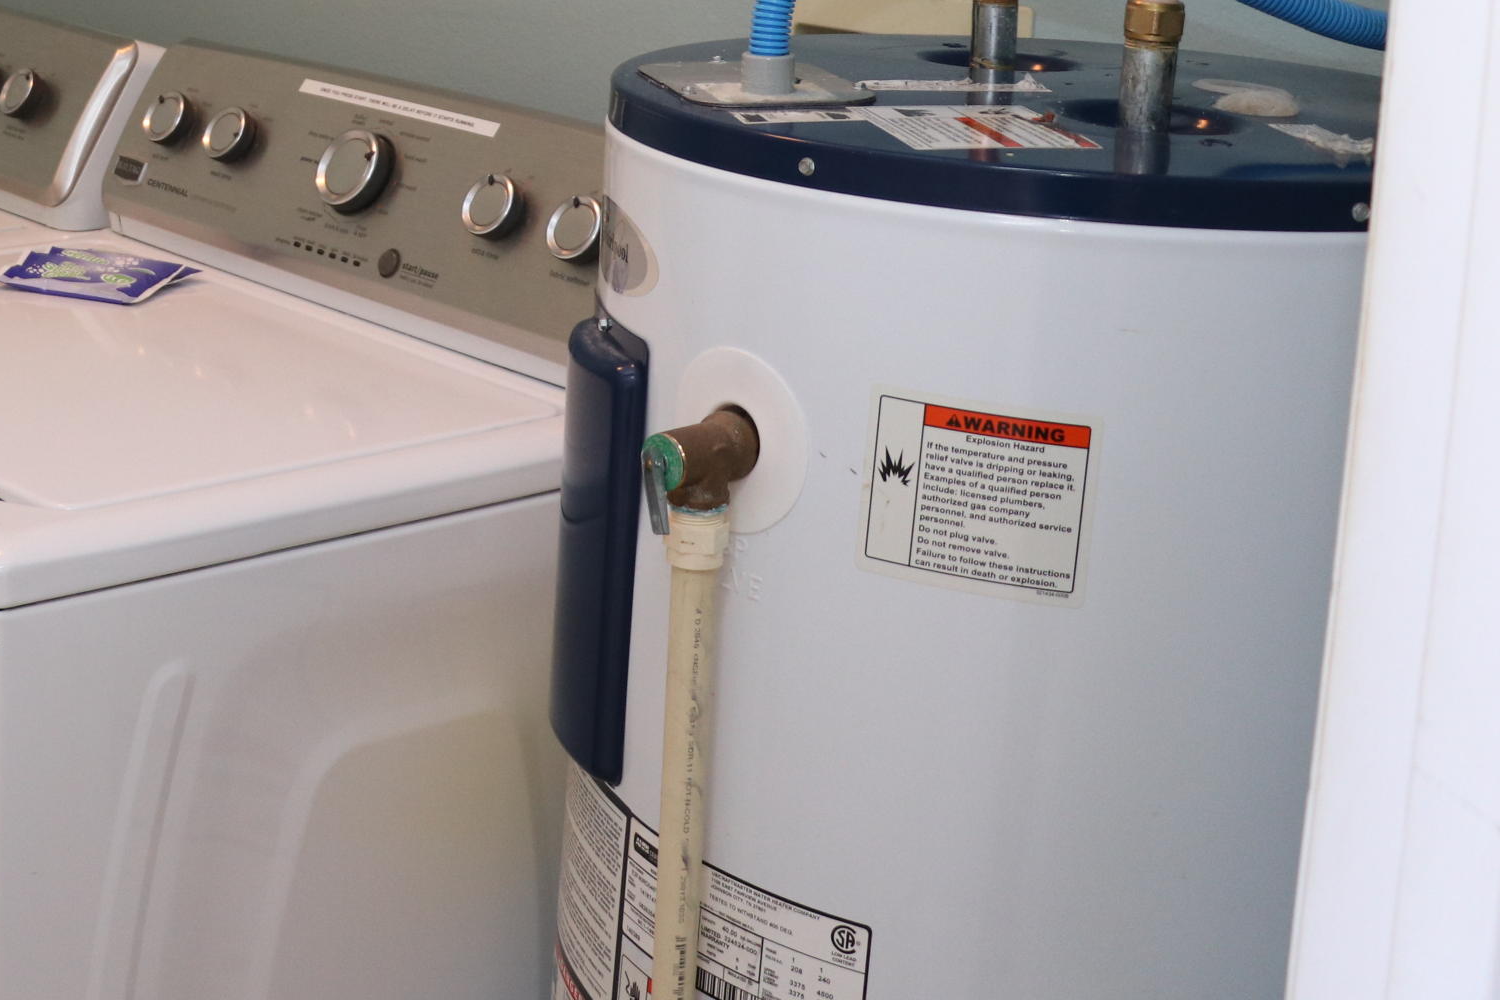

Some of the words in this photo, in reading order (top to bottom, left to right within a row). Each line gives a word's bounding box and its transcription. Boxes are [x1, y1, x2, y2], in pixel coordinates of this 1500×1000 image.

[147, 179, 188, 197] CENTENNIAL
[964, 416, 1065, 442] WARNING
[927, 441, 933, 449] If
[935, 443, 949, 452] the
[951, 446, 1005, 461] temperature
[1007, 456, 1025, 464] and
[1027, 458, 1068, 470] pressure
[966, 434, 1011, 449] Explosion
[1013, 441, 1045, 454] Hazard
[926, 452, 948, 462] relief
[950, 457, 974, 467] valve
[976, 460, 984, 468] is
[986, 462, 1024, 476] dripping
[924, 461, 946, 472] have
[956, 468, 995, 481] qualified
[996, 475, 1028, 486] person
[1030, 480, 1065, 491] replace
[1066, 483, 1076, 492] it.
[924, 471, 966, 486] Examples
[988, 484, 1028, 496] qualified
[1029, 489, 1062, 500] person
[922, 493, 968, 508] authorized
[970, 502, 987, 511] gas
[989, 505, 1031, 519] company
[960, 488, 998, 502] licensed
[1000, 496, 1046, 510] plumbers,
[919, 514, 966, 529] personnel.
[969, 512, 986, 521] and
[988, 514, 1037, 529] authorized
[1038, 523, 1073, 534] service
[918, 524, 931, 533] Do
[933, 528, 948, 537] not
[949, 531, 969, 542] plug
[971, 535, 998, 545] valve.
[917, 535, 930, 545] Do
[931, 540, 946, 548] not
[948, 543, 981, 554] remove
[984, 549, 1010, 559] valve.
[915, 558, 931, 567] can
[932, 562, 959, 573] result
[960, 567, 969, 575] in
[971, 569, 996, 580] death
[1010, 575, 1059, 588] explosion.
[916, 547, 946, 560] Failure
[948, 554, 957, 562] to
[959, 556, 987, 567] follow
[989, 561, 1014, 571] these
[1016, 565, 1071, 580] instructions
[729, 903, 737, 911] TO
[700, 930, 730, 950] WARRANTY
